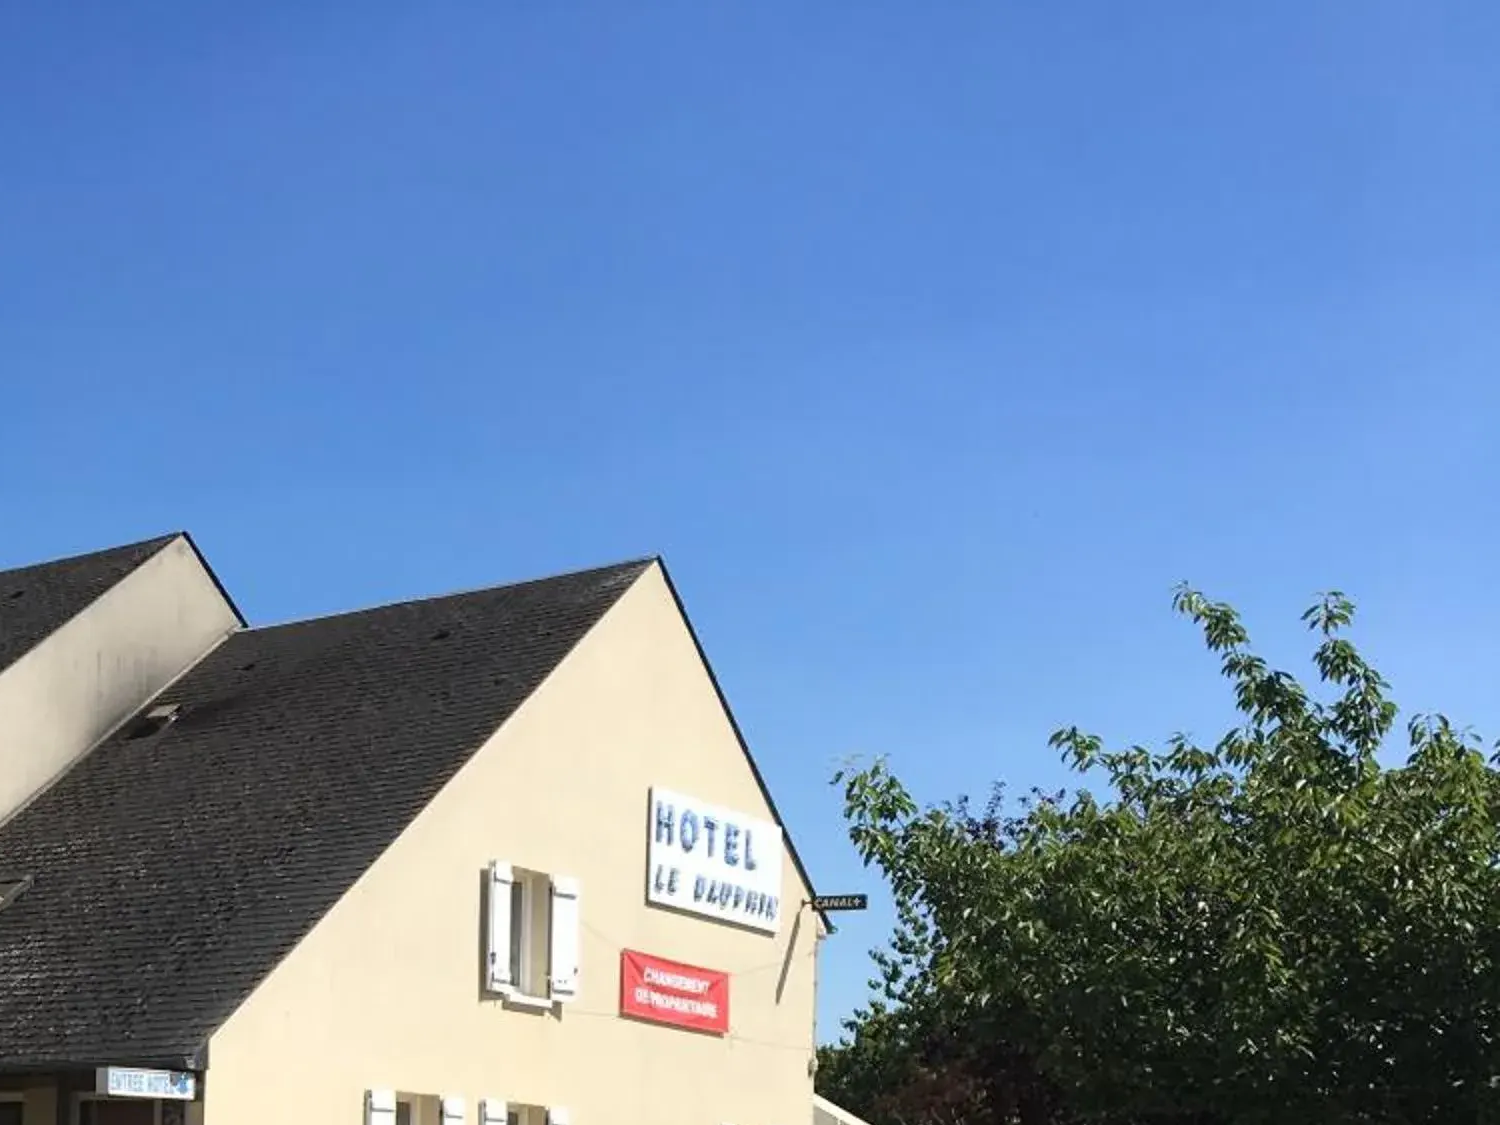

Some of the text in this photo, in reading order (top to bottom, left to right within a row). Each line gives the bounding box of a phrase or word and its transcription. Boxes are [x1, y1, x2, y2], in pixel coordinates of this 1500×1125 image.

[655, 800, 756, 871] HOTEL
[654, 864, 779, 921] LE DAUPHIN
[814, 896, 862, 909] CANAL+
